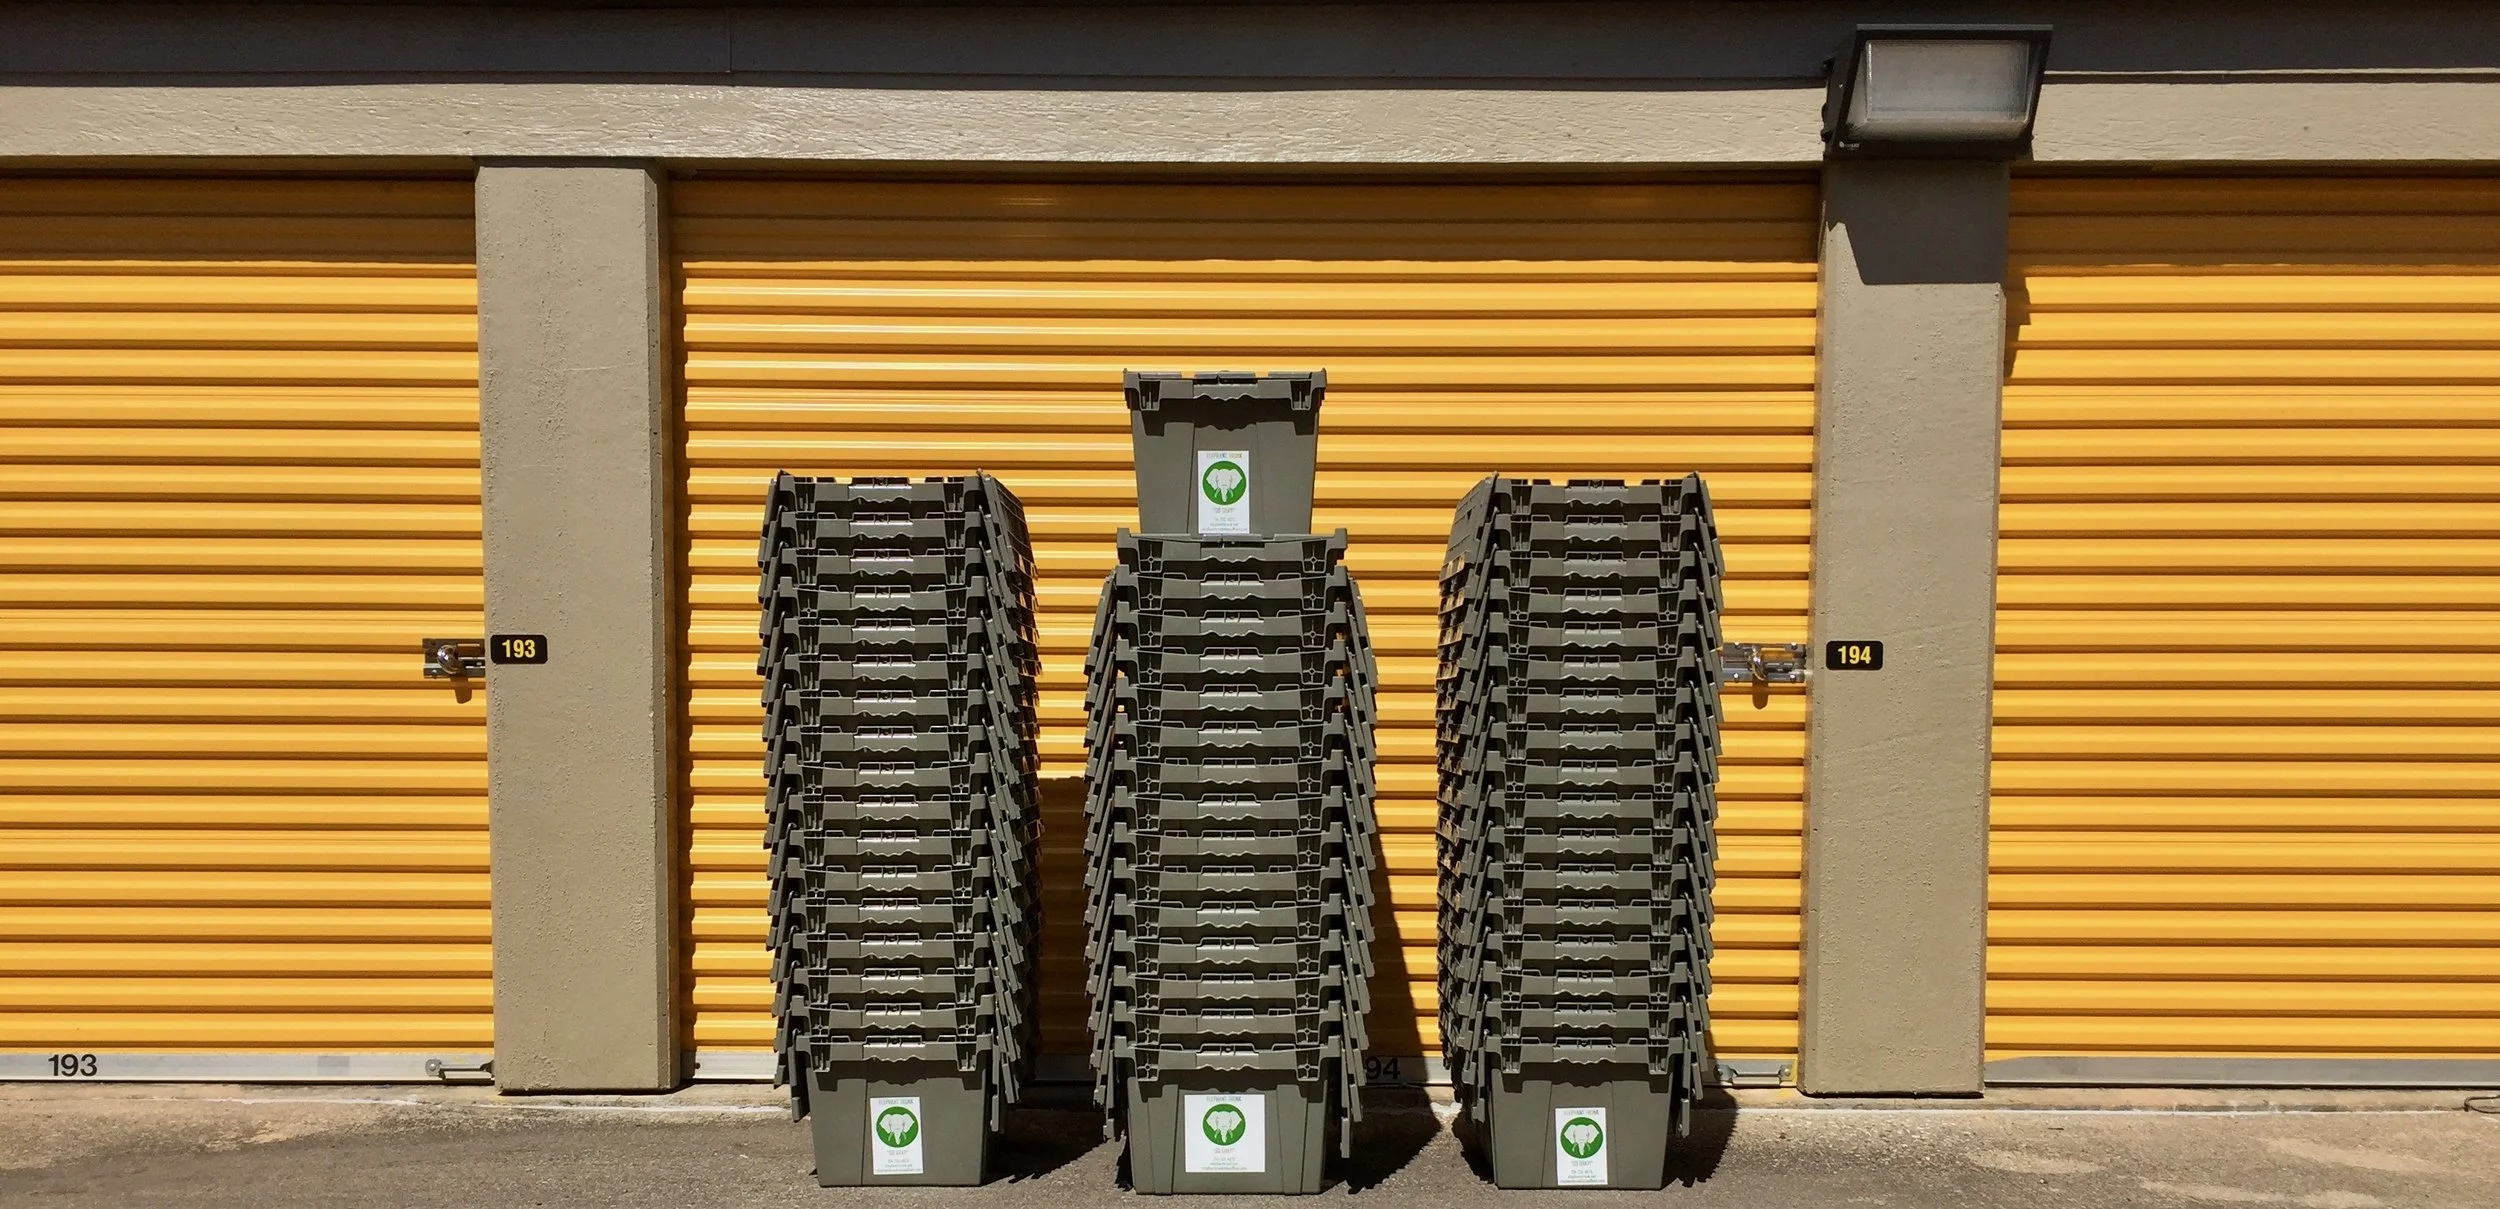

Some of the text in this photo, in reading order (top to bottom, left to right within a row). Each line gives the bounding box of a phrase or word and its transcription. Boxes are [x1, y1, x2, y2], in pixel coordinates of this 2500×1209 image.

[502, 639, 536, 658] 193
[1837, 645, 1872, 665] 194
[48, 1053, 98, 1077] 193
[1365, 1056, 1401, 1080] 94
